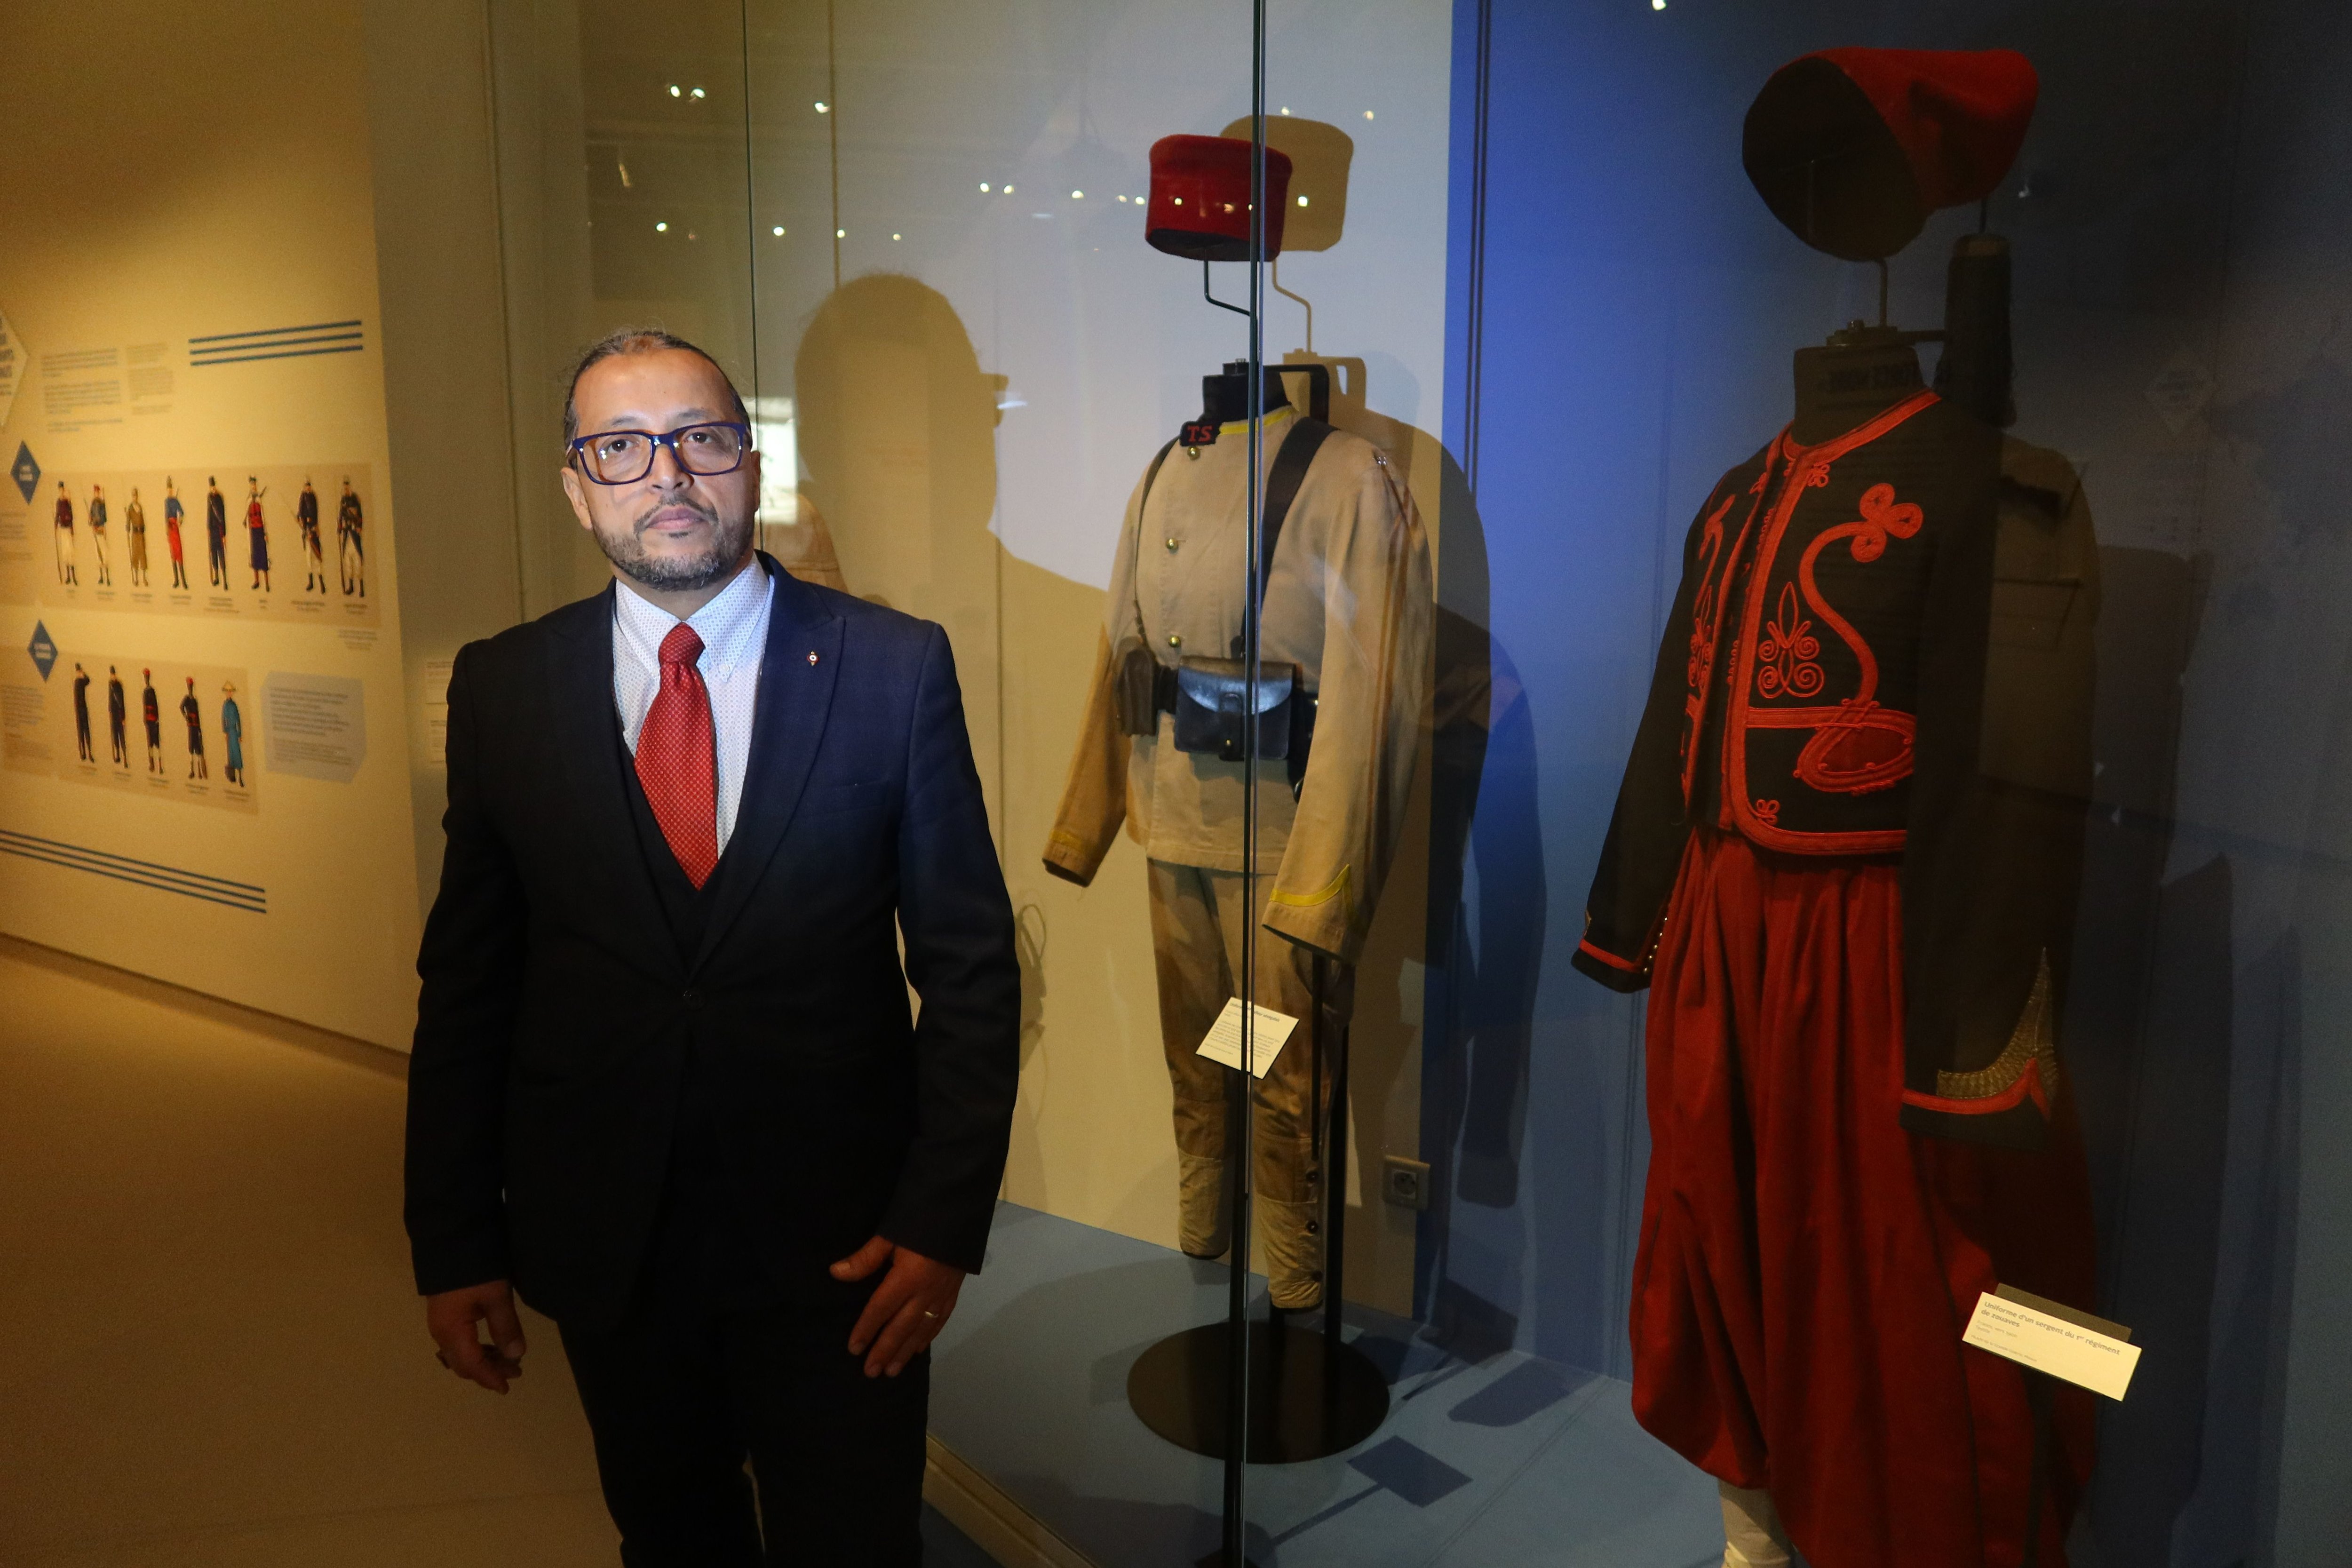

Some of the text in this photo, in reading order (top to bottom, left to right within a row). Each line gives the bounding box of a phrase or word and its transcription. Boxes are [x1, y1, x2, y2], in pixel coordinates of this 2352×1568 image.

[1187, 425, 1213, 442] TS
[1984, 1301, 2018, 1318] Uniforme
[2035, 1321, 2064, 1335] sergent
[2085, 1338, 2121, 1355] régiment
[1991, 1313, 2020, 1328] zouaves
